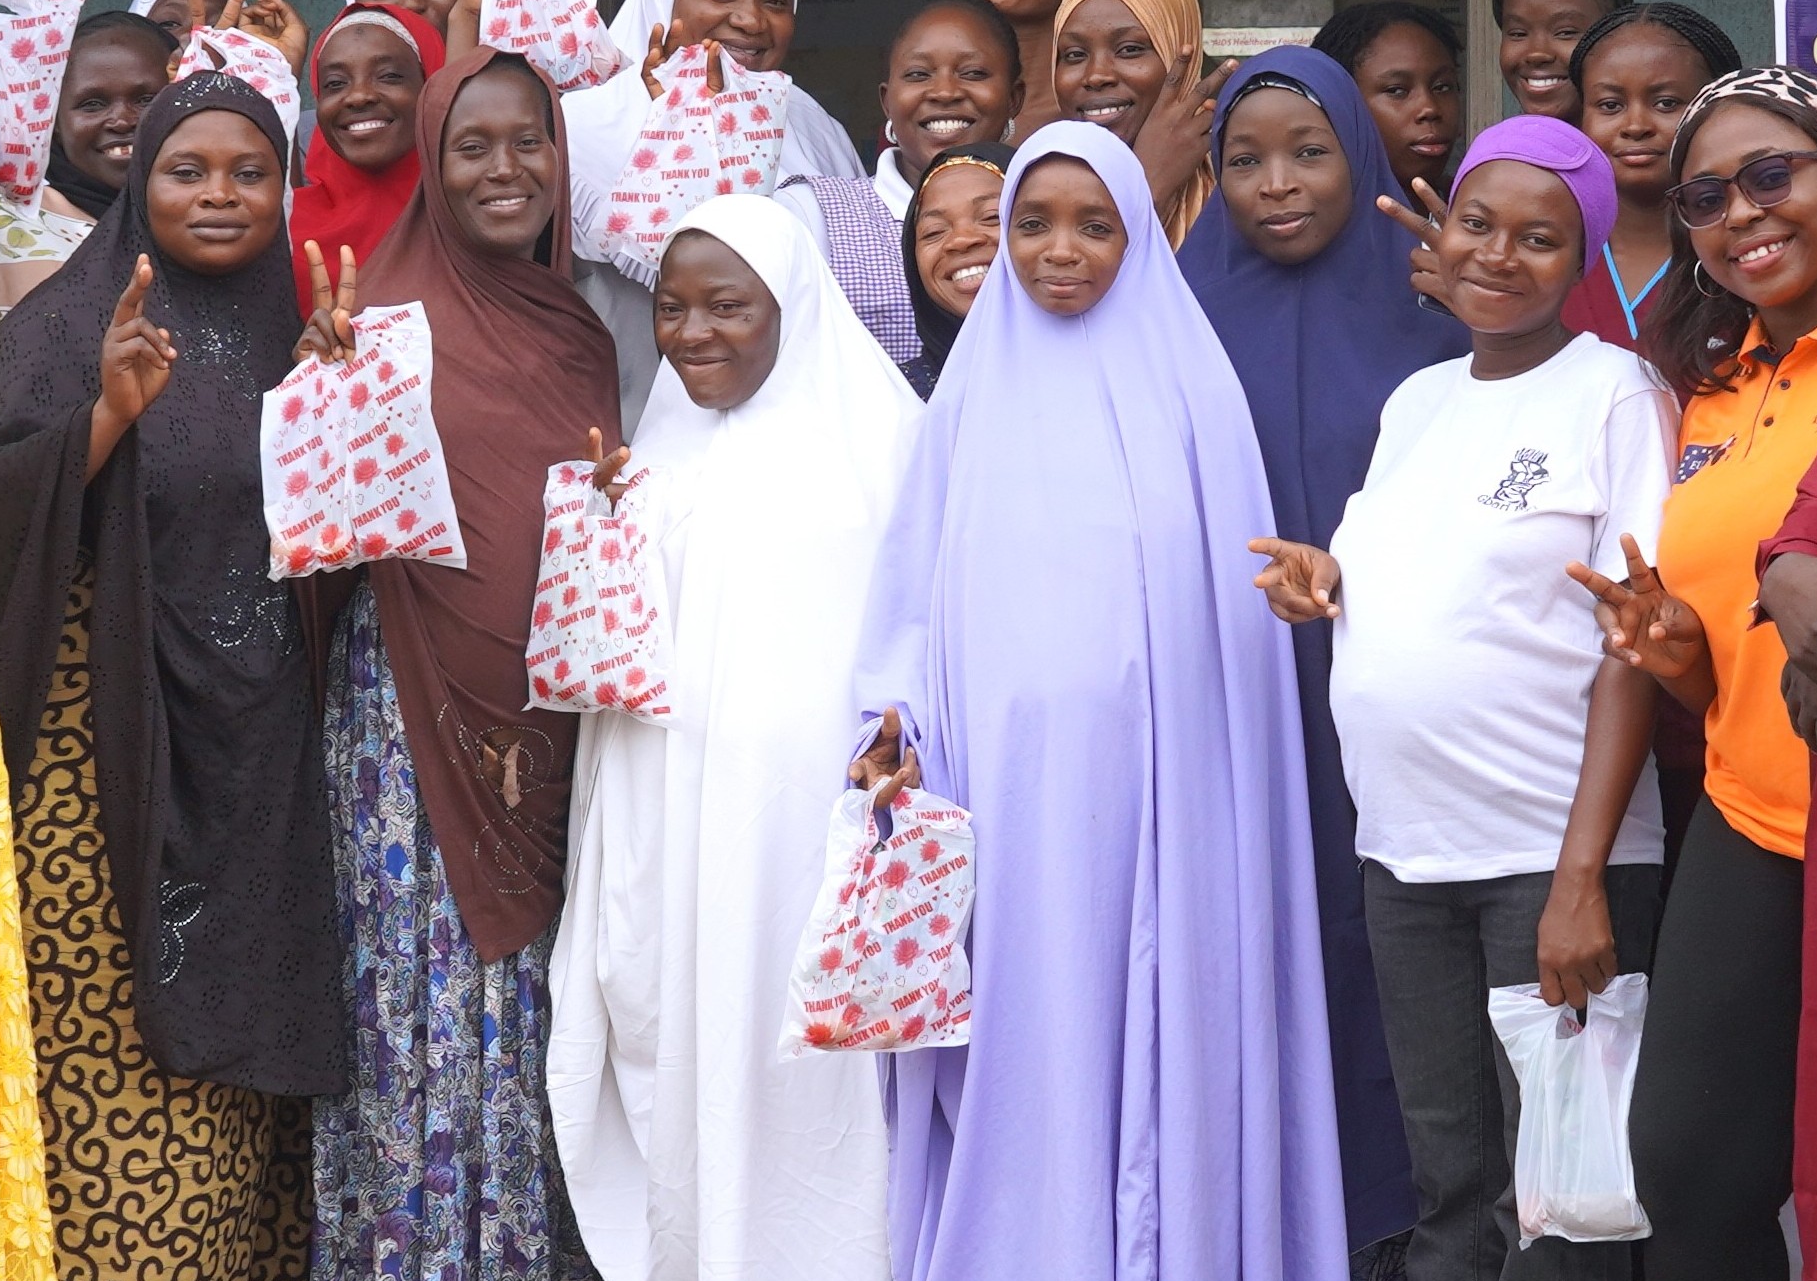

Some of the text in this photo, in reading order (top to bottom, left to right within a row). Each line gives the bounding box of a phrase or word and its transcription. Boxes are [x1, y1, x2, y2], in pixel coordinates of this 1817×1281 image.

[714, 91, 757, 108] THANK YOU
[640, 130, 684, 140] THANK YOU
[744, 130, 773, 141] THANK
[661, 168, 710, 180] THANK YOU
[611, 193, 660, 203] THANK YOU
[390, 309, 411, 325] YOU
[337, 358, 363, 382] THANK
[376, 374, 422, 407] THANK YOU
[277, 444, 305, 467] THANK
[305, 435, 323, 453] YOU
[385, 448, 431, 482] THANK YOU
[353, 497, 400, 529] THANK YOU
[565, 499, 584, 513] YOU
[281, 521, 311, 542] THANK
[396, 521, 447, 556] THANK YOU
[553, 571, 569, 586] YOU
[556, 605, 596, 630] THANK YOU
[545, 644, 560, 660] YOU
[650, 681, 667, 697] YOU
[905, 825, 924, 842] YOU
[918, 854, 968, 887] THANK YOU
[882, 910, 915, 936] THANK
[914, 900, 934, 918] YOU
[863, 941, 882, 961] YOU
[891, 978, 940, 1013] THANK YOU
[804, 998, 834, 1014] THANK
[838, 1019, 891, 1048] THANK YOU
